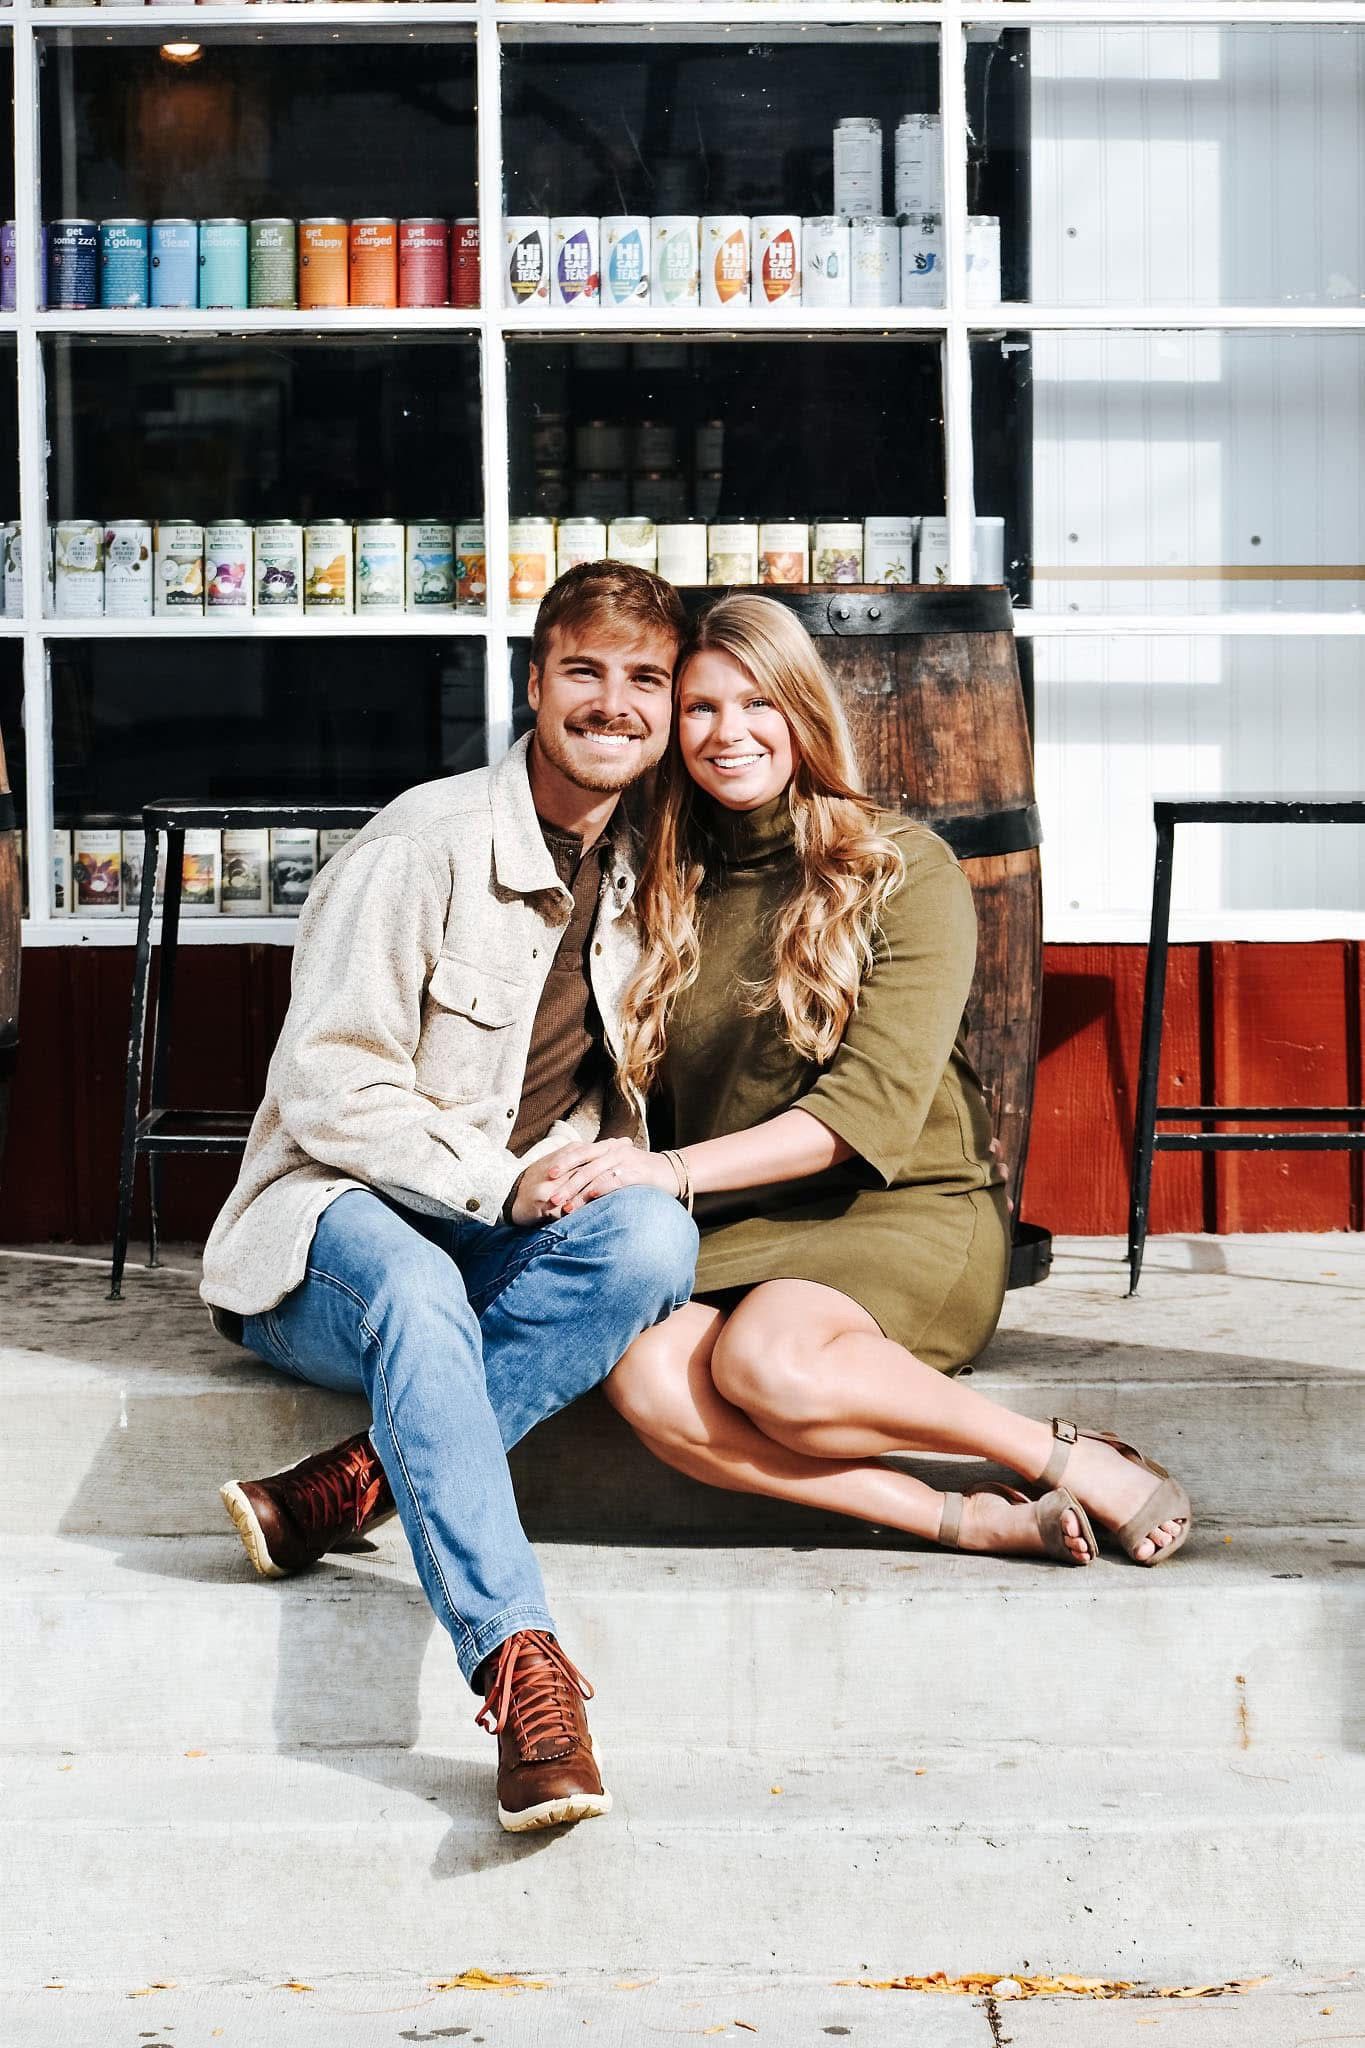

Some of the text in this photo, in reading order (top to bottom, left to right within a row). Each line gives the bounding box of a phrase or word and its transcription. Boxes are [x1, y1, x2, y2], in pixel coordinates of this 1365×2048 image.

[66, 228, 83, 237] get
[108, 228, 126, 238] get
[159, 229, 176, 239] get
[260, 228, 278, 238] get
[306, 229, 321, 239] get
[360, 227, 377, 237] get
[407, 228, 425, 238] get
[466, 228, 480, 238] ge
[104, 237, 141, 249] it going
[256, 236, 283, 247] relief
[311, 236, 342, 248] happy
[354, 235, 392, 247] charged
[769, 268, 793, 279] TEAS
